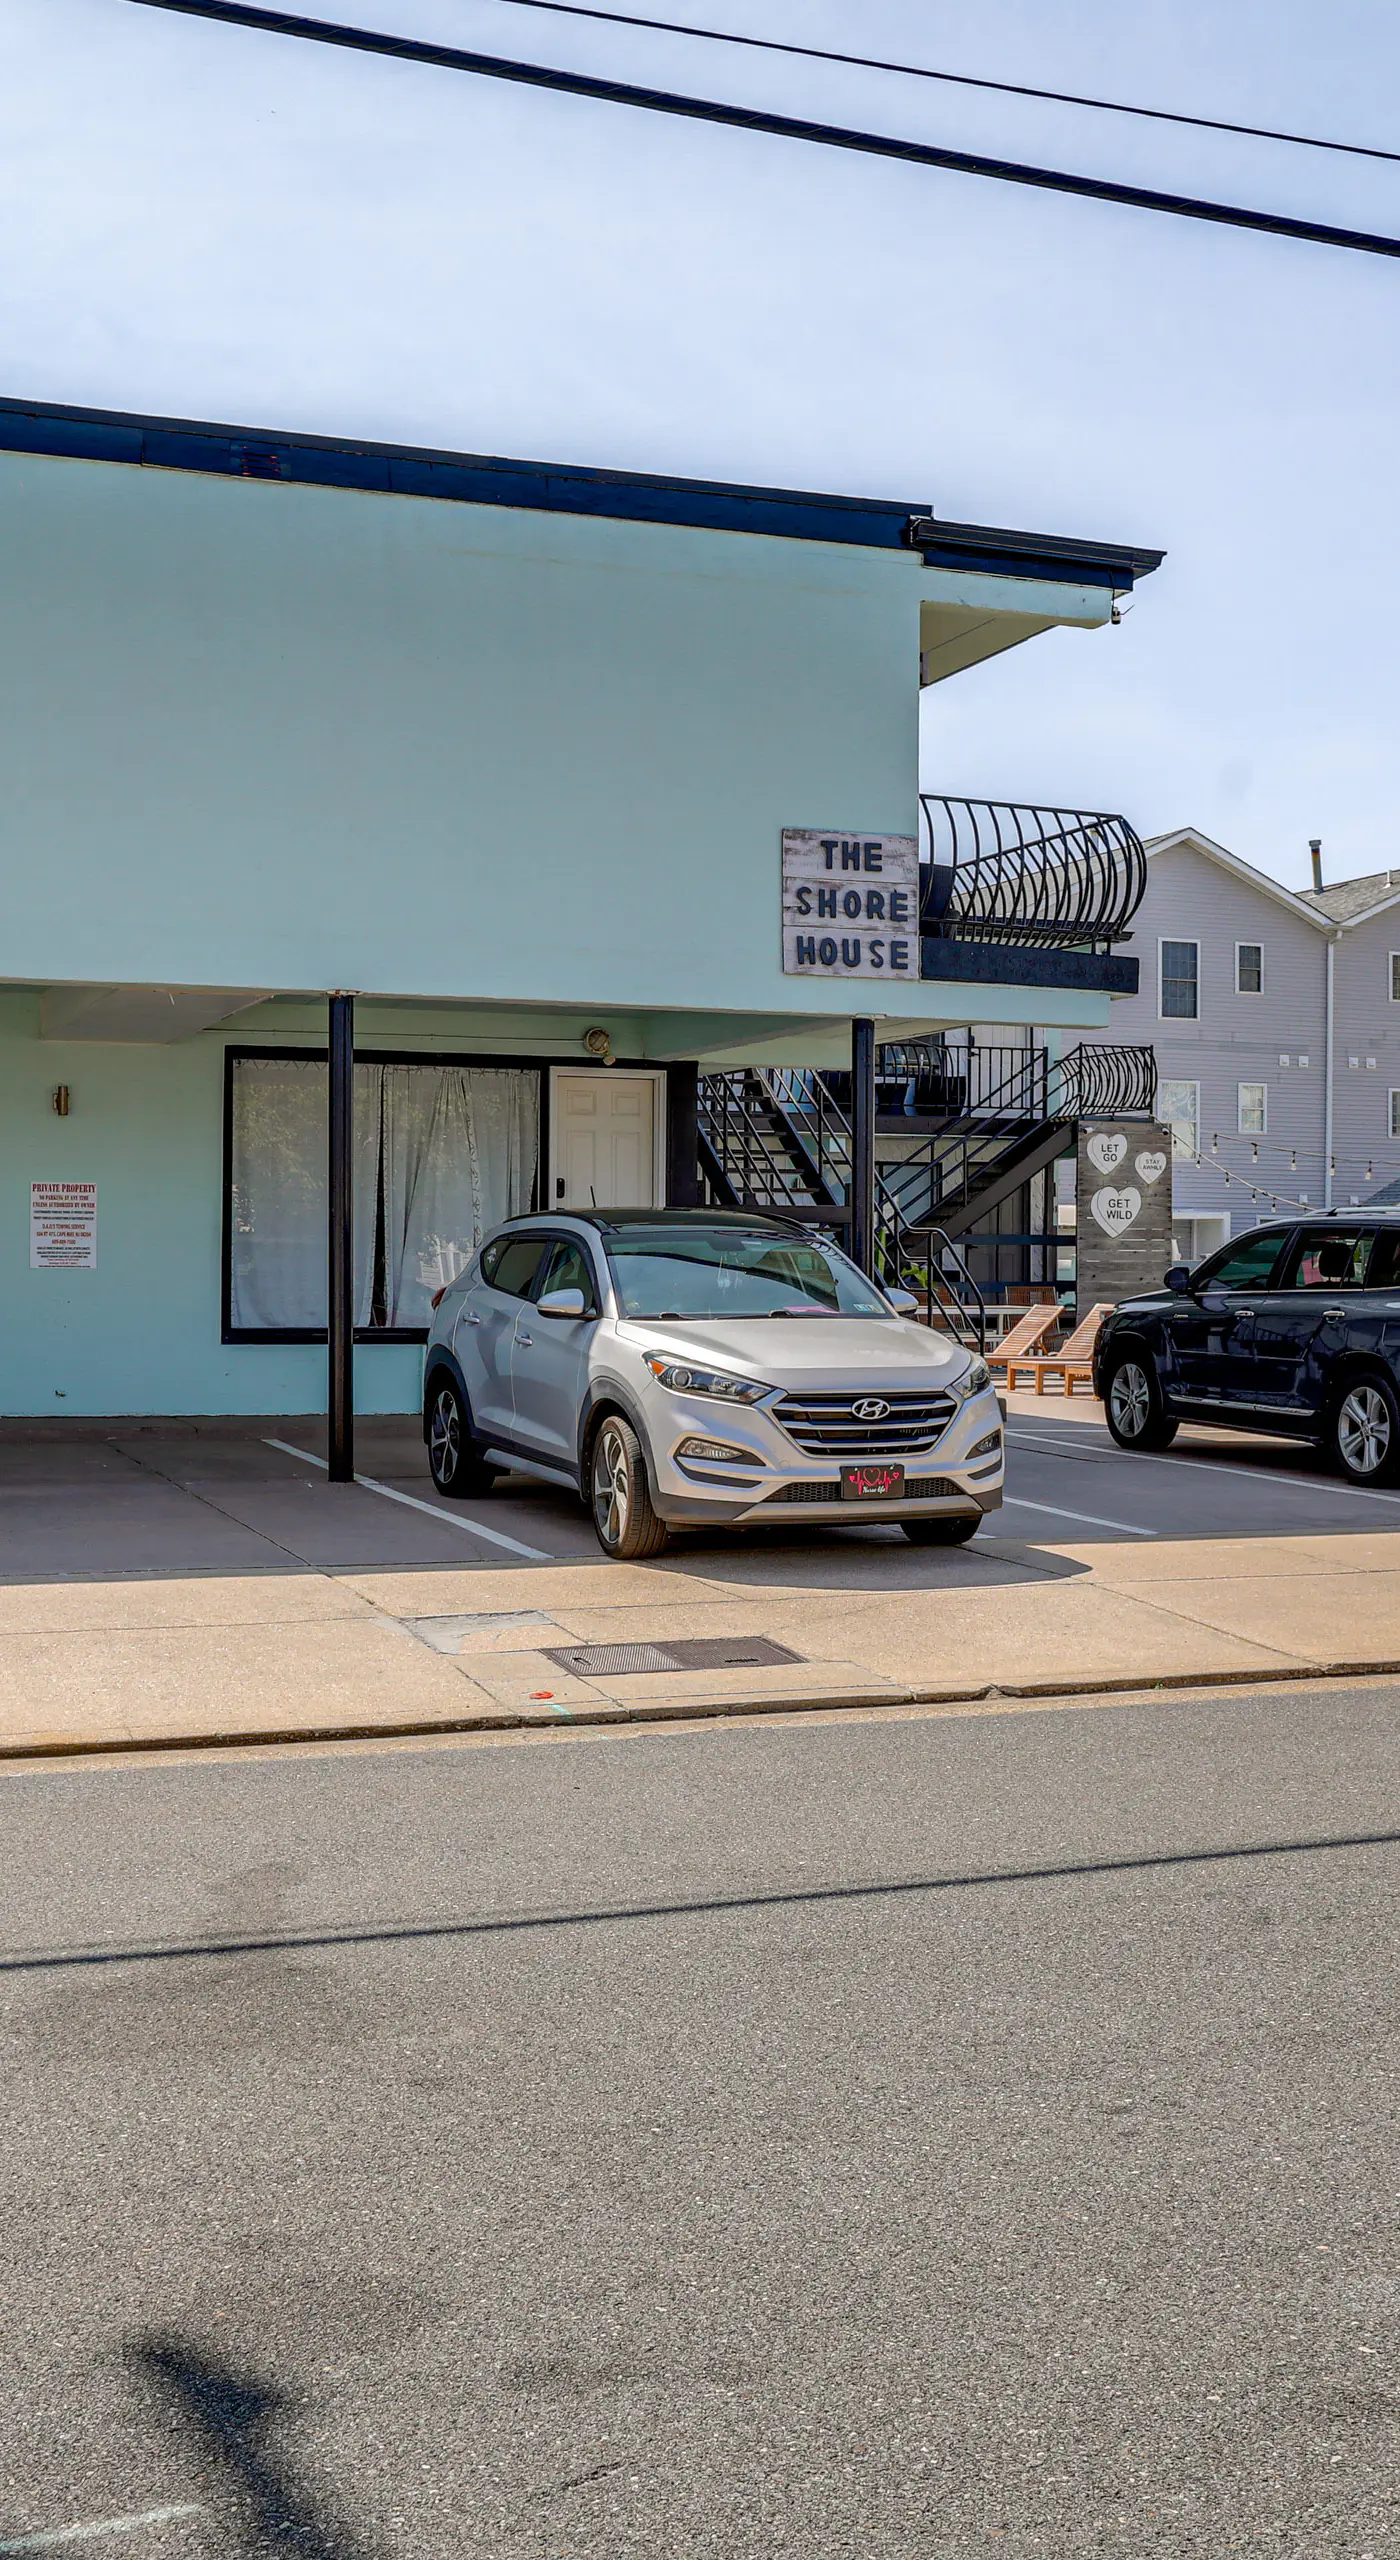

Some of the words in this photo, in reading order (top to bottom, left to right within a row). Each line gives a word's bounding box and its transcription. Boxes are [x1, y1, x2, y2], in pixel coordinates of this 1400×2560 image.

[820, 839, 883, 872] THE
[796, 886, 908, 922] SHORE
[796, 935, 909, 970] HOUSE
[1101, 1144, 1119, 1153] LET
[1103, 1153, 1118, 1162] GO
[32, 1184, 61, 1192] PRIVATE
[62, 1184, 96, 1193] PROPERTY
[1108, 1199, 1131, 1208] GET
[1106, 1210, 1133, 1220] WILD
